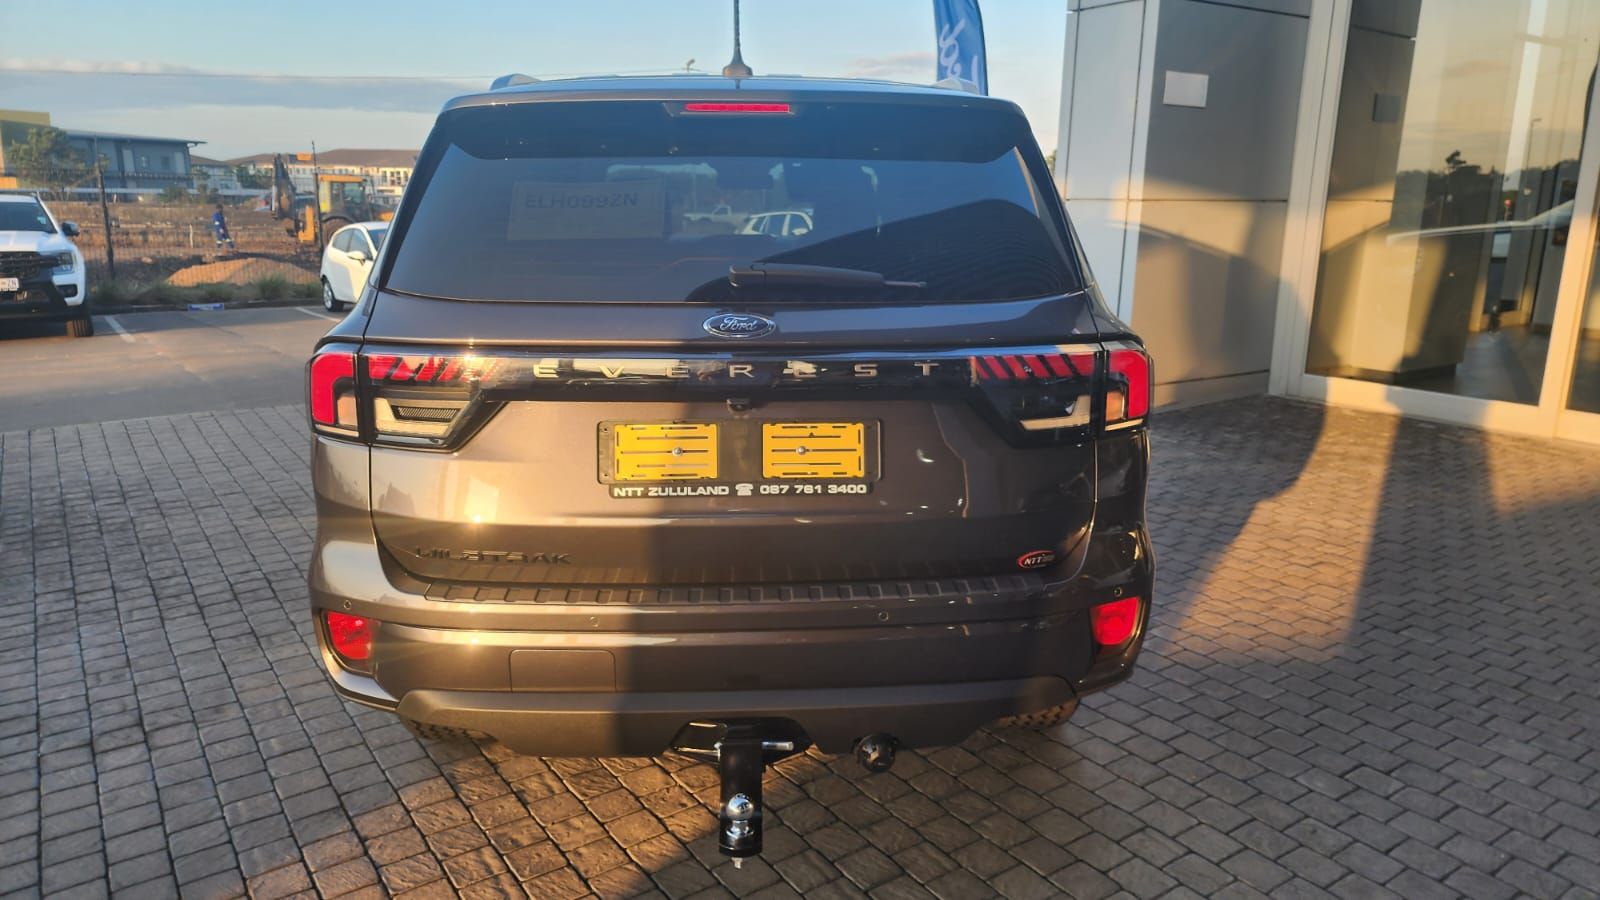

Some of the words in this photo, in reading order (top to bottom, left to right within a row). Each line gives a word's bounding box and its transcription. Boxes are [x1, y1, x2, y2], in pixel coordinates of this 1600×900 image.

[533, 360, 940, 379] EVEREST
[613, 487, 644, 497] NTT
[648, 486, 730, 496] ZULULAND
[760, 485, 789, 494] 087
[794, 484, 822, 494] 761
[827, 484, 867, 494] 3400
